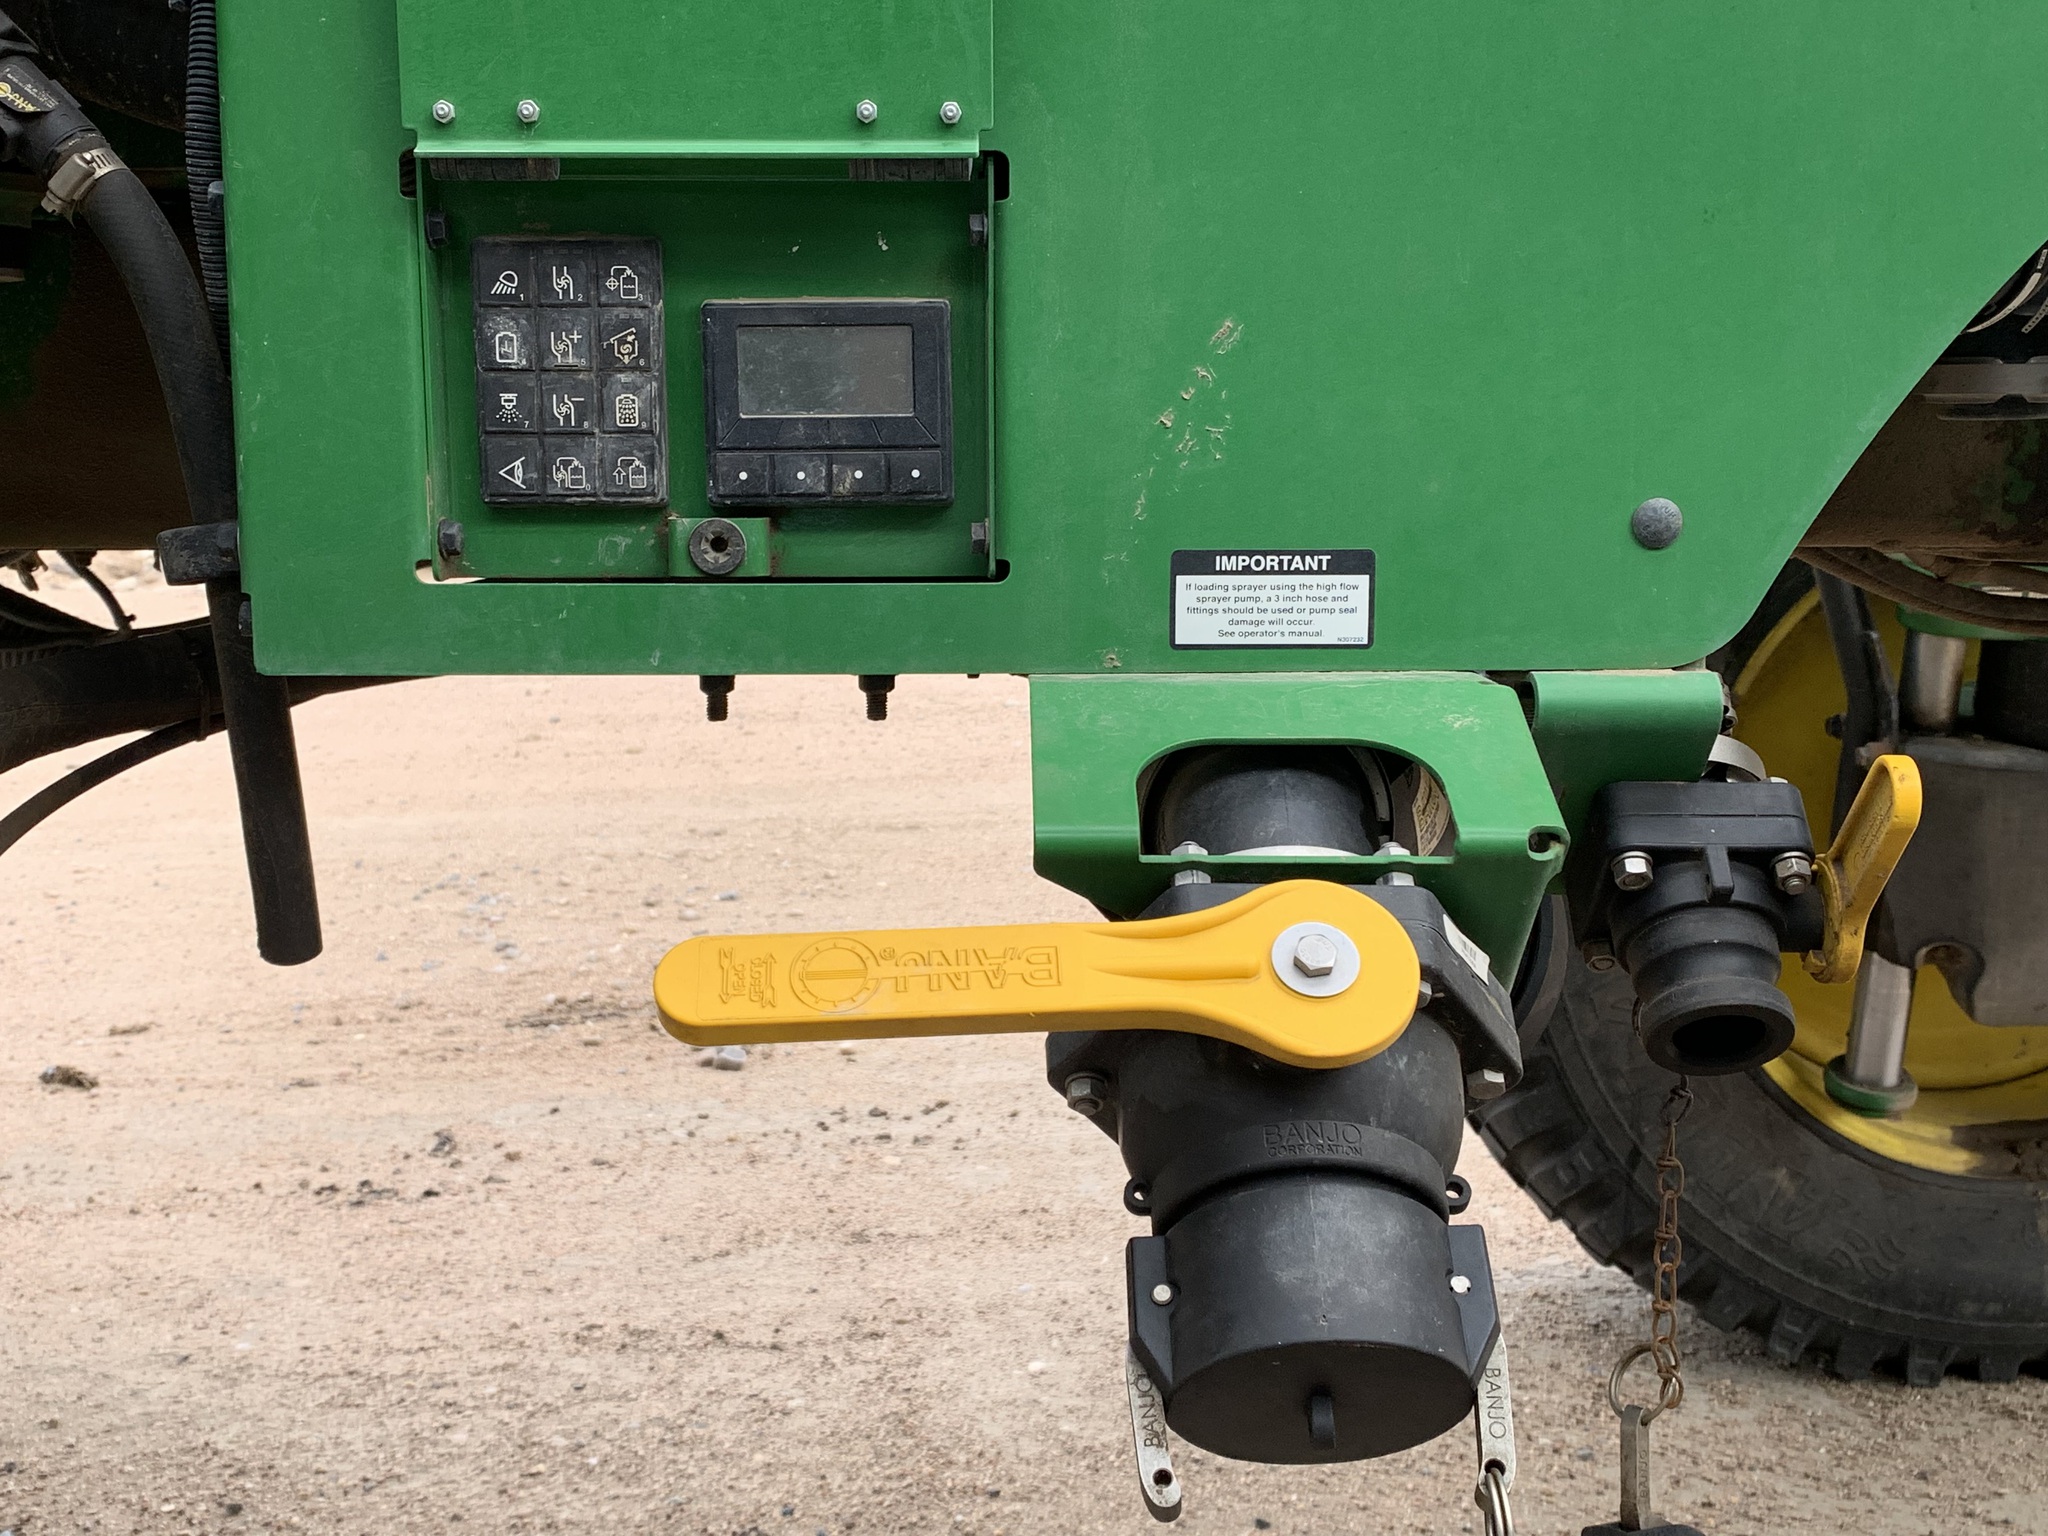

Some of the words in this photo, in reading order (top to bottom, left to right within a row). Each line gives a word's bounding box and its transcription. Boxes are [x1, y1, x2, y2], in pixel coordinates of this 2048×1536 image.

[1215, 555, 1331, 571] IMPORTANT
[1195, 583, 1229, 592] loading
[1232, 584, 1267, 592] sprayer
[1270, 583, 1296, 592] using
[1317, 583, 1336, 592] high
[1196, 596, 1231, 604] sprayer
[1187, 607, 1219, 616] fittings
[1271, 606, 1293, 614] used
[1309, 607, 1335, 615] pump
[1339, 606, 1357, 614] seal
[1228, 618, 1265, 627] damage
[1238, 630, 1285, 638] operator's
[732, 963, 746, 997] OPEN
[749, 956, 763, 1003] CLOSED
[1262, 1121, 1363, 1147] BANJO
[1267, 1143, 1363, 1158] CORPORATION
[1135, 1373, 1161, 1448] BANJO
[1484, 1367, 1507, 1440] BANJO
